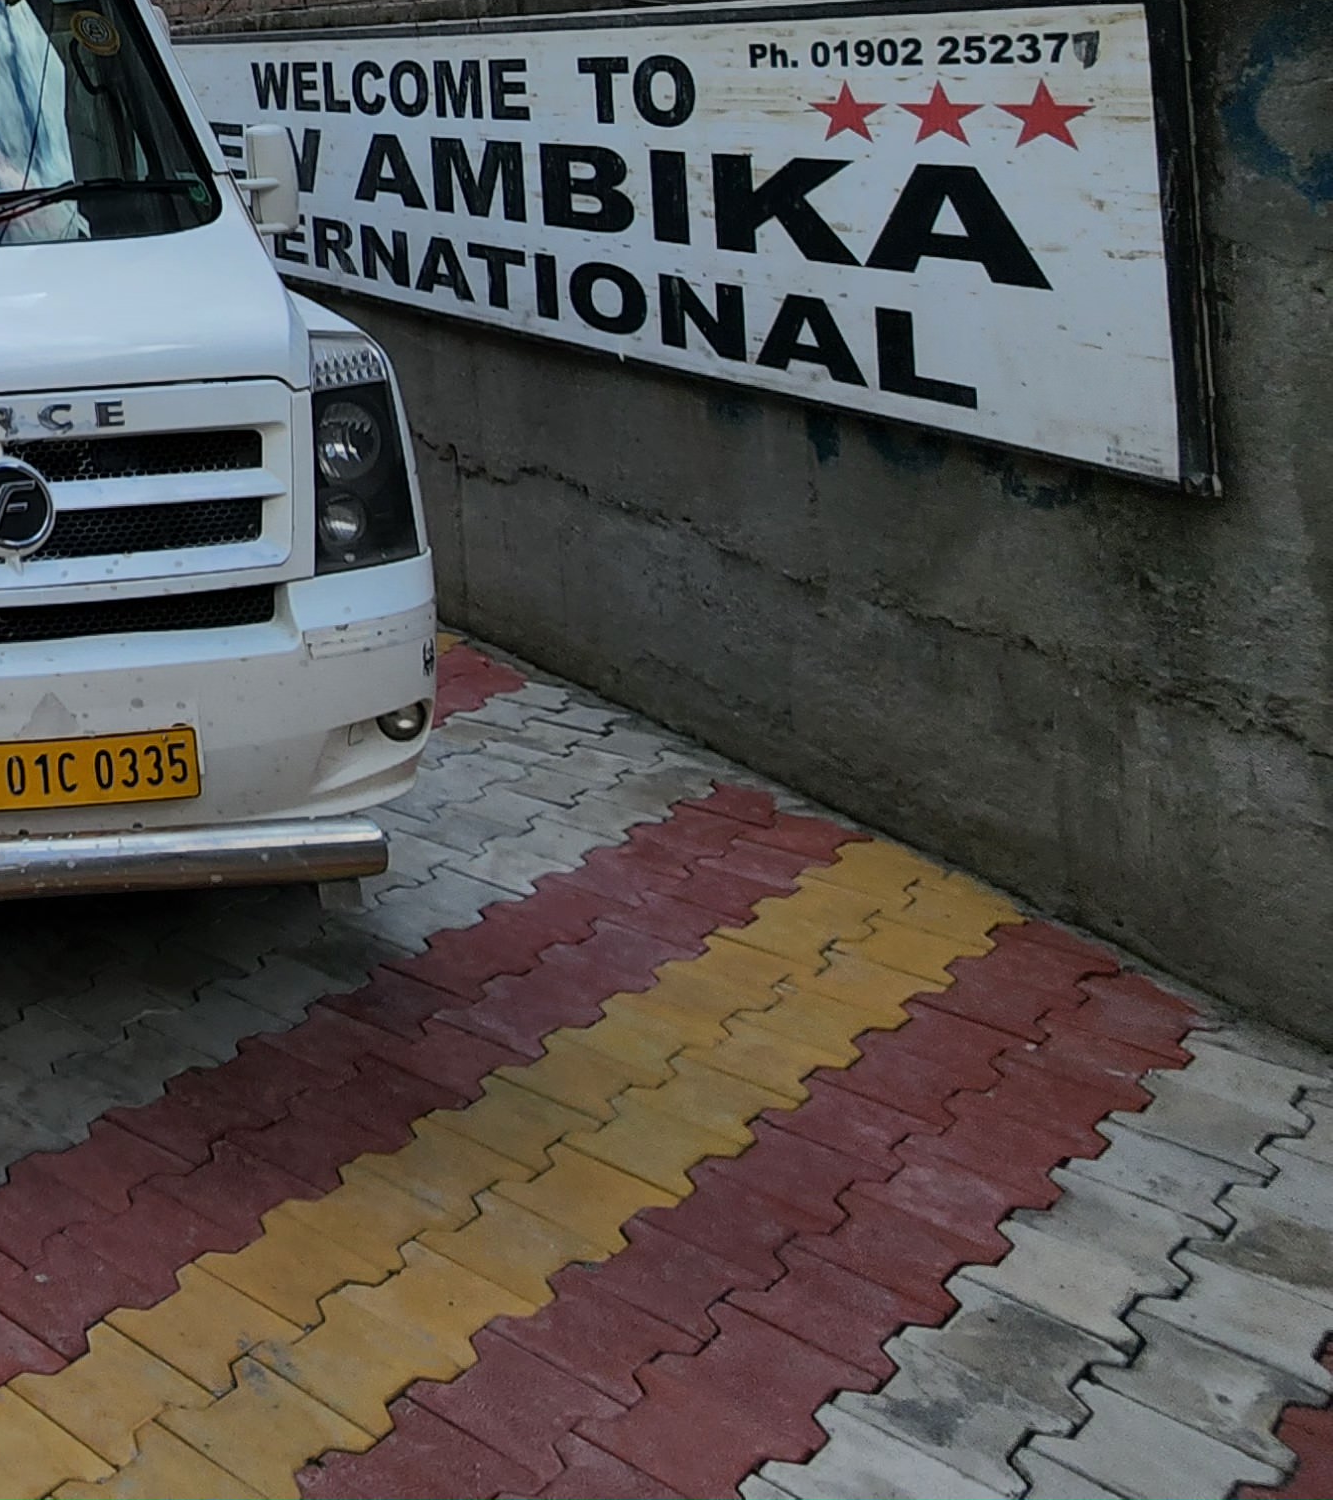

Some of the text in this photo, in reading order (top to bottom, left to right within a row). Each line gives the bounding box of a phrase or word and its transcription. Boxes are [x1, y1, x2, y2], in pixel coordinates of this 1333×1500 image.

[749, 42, 799, 69] Ph.
[810, 37, 923, 68] 01902
[251, 54, 696, 128] WELCOME TO
[354, 133, 1054, 291] AMBIKA
[6, 752, 78, 796] 01C
[94, 742, 189, 790] 0335
